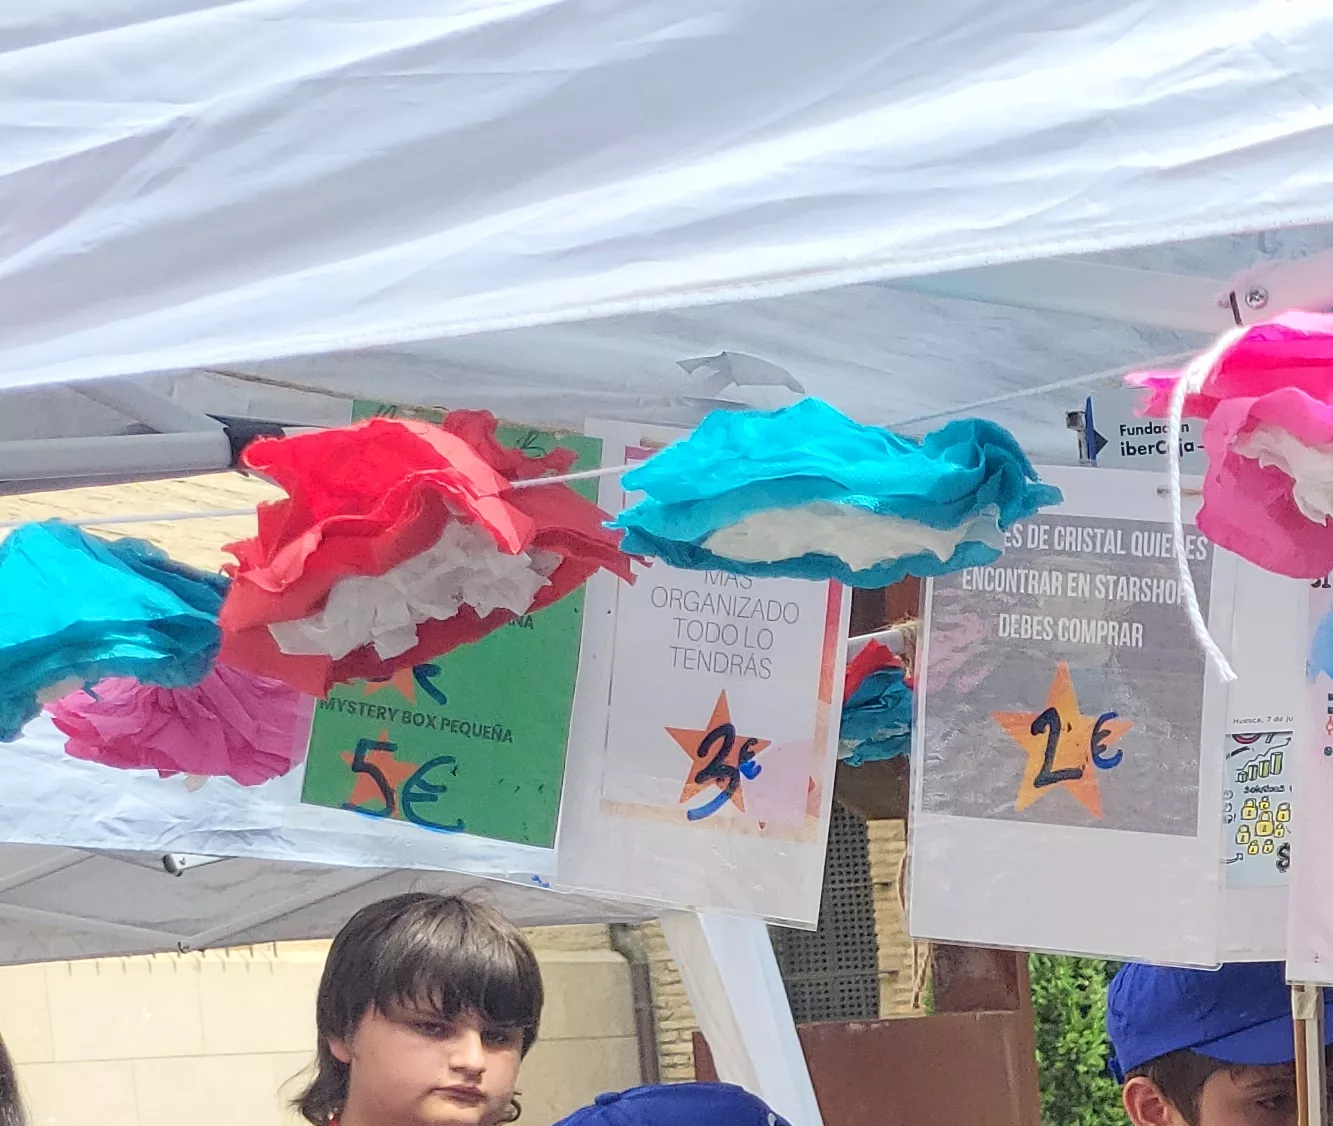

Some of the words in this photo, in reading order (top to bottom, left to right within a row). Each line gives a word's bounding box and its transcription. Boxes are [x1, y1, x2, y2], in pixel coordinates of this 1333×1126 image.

[1120, 421, 1189, 436] Fundacn
[1121, 439, 1194, 457] iberCja
[1027, 524, 1050, 550] DE
[1054, 526, 1126, 555] CRISTAL
[962, 567, 1063, 595] ENCONTRAR
[1067, 573, 1090, 598] EN
[651, 586, 800, 624] ORGANIZADO
[673, 617, 738, 645] TODO
[744, 628, 774, 650] LO
[999, 613, 1053, 641] DEBES
[1058, 617, 1143, 648] COMPRAR
[669, 645, 772, 679] TENDRÁS
[319, 697, 398, 722] MYSTERY
[401, 711, 437, 728] BOX
[439, 719, 513, 744] PEQUEÑA
